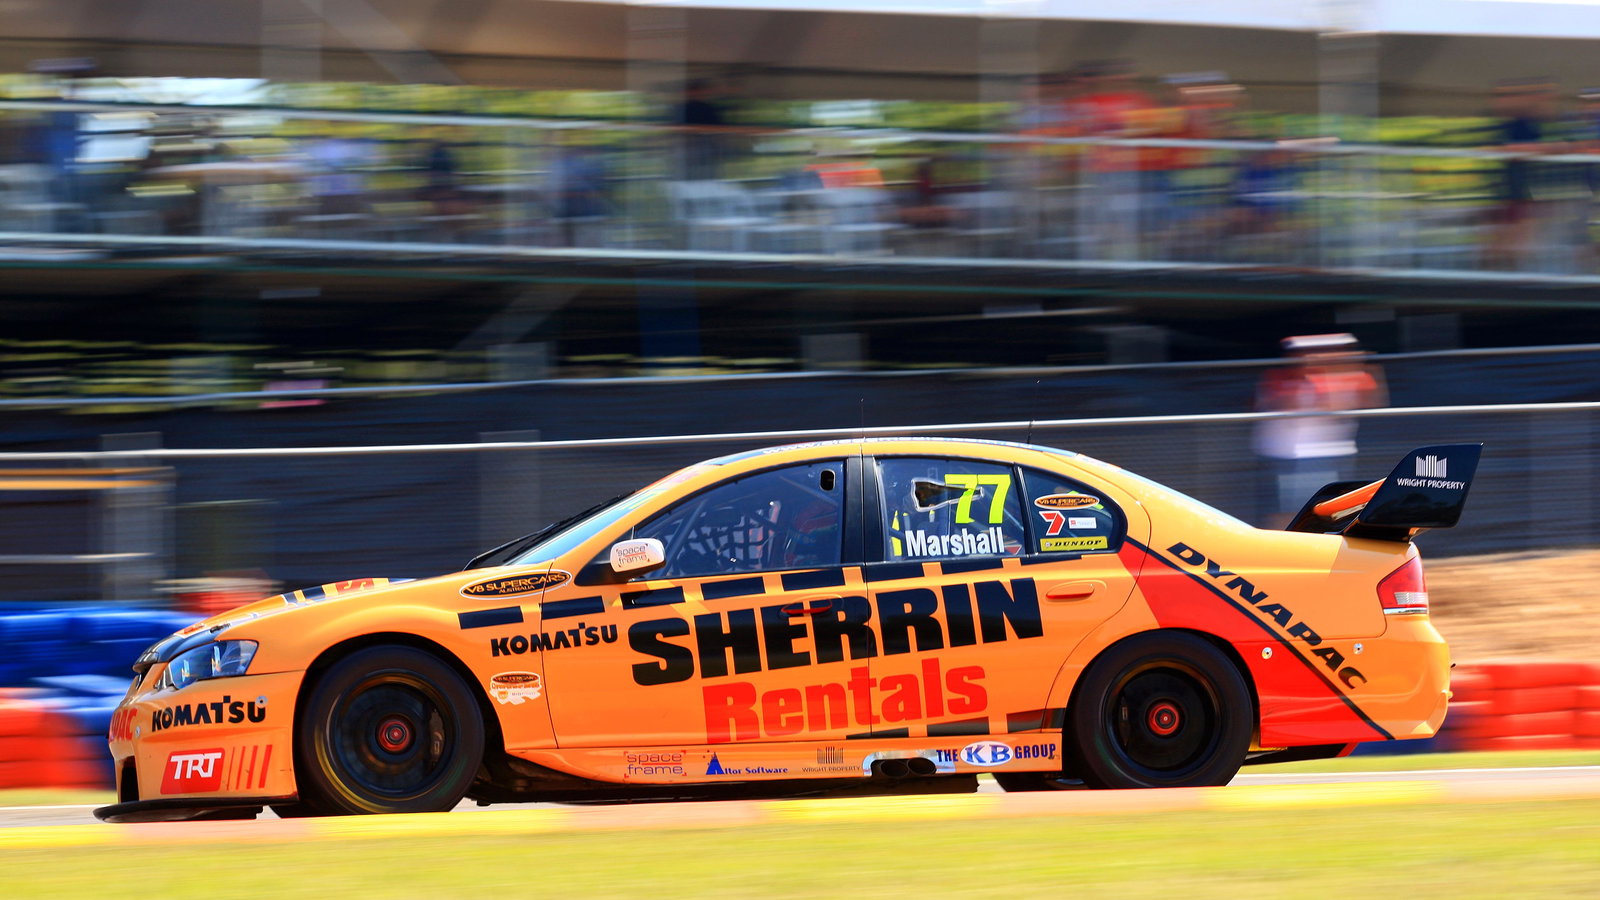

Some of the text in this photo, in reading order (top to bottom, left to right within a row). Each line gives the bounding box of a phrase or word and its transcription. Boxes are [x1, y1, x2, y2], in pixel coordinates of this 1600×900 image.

[1397, 478, 1465, 490] WRIGHT PROPERTY
[945, 474, 1011, 524] 77
[617, 545, 646, 557] space
[905, 527, 1005, 557] Marshall
[465, 574, 566, 594] V8 SUPERCARS
[1166, 541, 1368, 690] DYNAPAC
[490, 622, 618, 657] KOMATSU
[627, 577, 1044, 686] SHERRIN
[702, 657, 988, 744] Rentals
[152, 695, 266, 732] KOMATSU
[627, 752, 682, 765] space
[936, 748, 959, 763] THE
[1014, 743, 1056, 759] GROUP
[170, 752, 222, 779] TRT
[627, 764, 683, 775] frame
[745, 766, 788, 775] Software
[828, 764, 861, 773] PROPERTY
